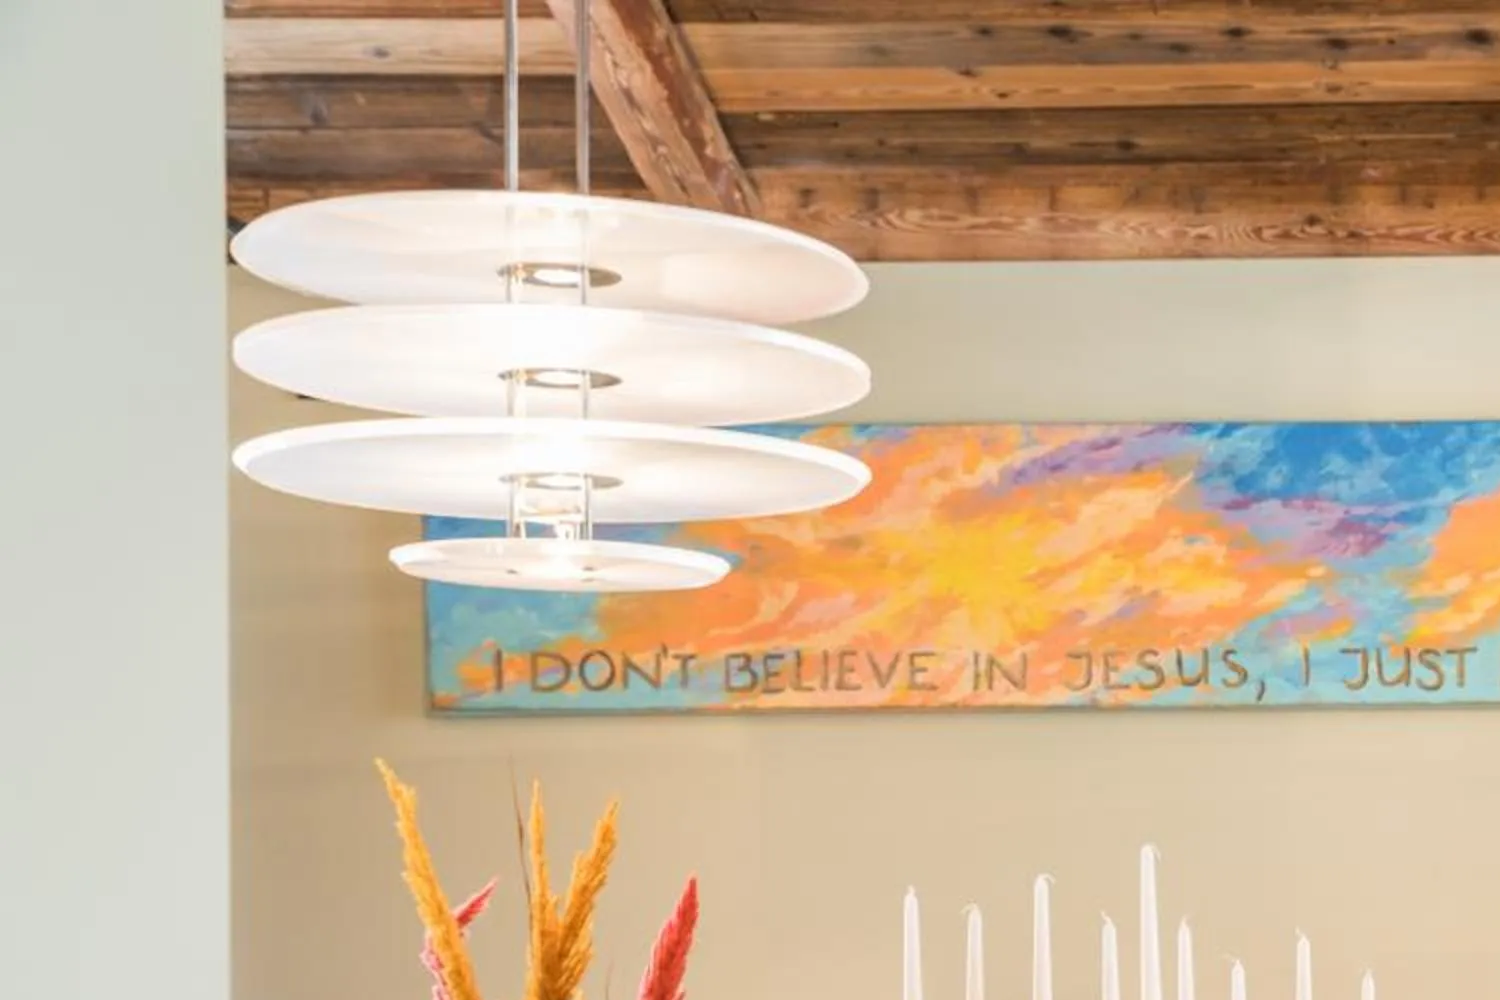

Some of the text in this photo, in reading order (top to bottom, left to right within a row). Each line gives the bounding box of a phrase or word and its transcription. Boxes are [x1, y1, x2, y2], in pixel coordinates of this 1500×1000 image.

[495, 649, 503, 691] I
[530, 644, 695, 692] DON'T
[724, 650, 938, 694] BELIEVE
[973, 651, 1026, 691] IN
[1065, 647, 1265, 701] JESUS,
[1302, 647, 1311, 686] I
[1339, 646, 1477, 691] JUST
